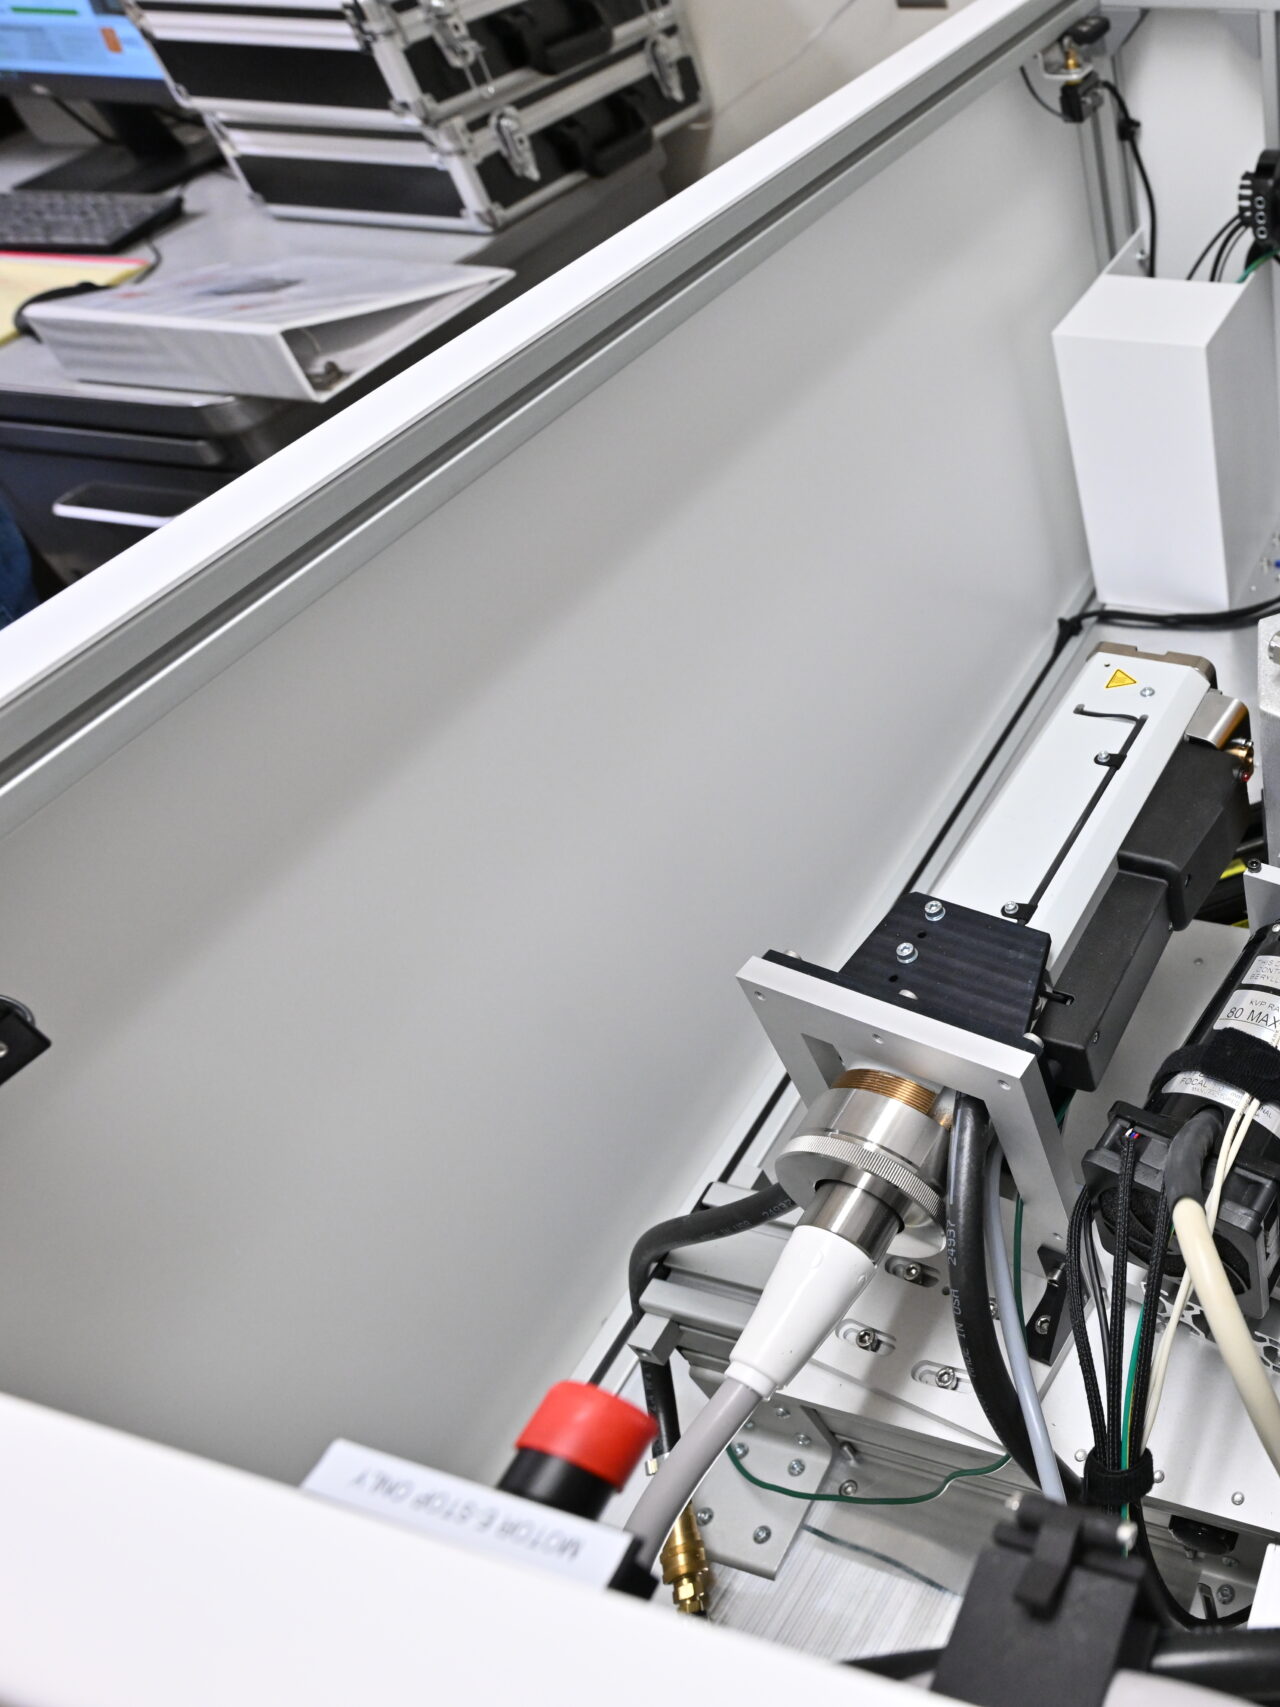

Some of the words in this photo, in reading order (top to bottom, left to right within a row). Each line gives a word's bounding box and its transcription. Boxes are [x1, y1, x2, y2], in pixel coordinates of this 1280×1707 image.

[1226, 1007, 1244, 1019] 80
[946, 1218, 957, 1267] 24937
[949, 1288, 962, 1316] USA
[350, 1468, 416, 1503] ONLY
[495, 1516, 585, 1561] MOTOR
